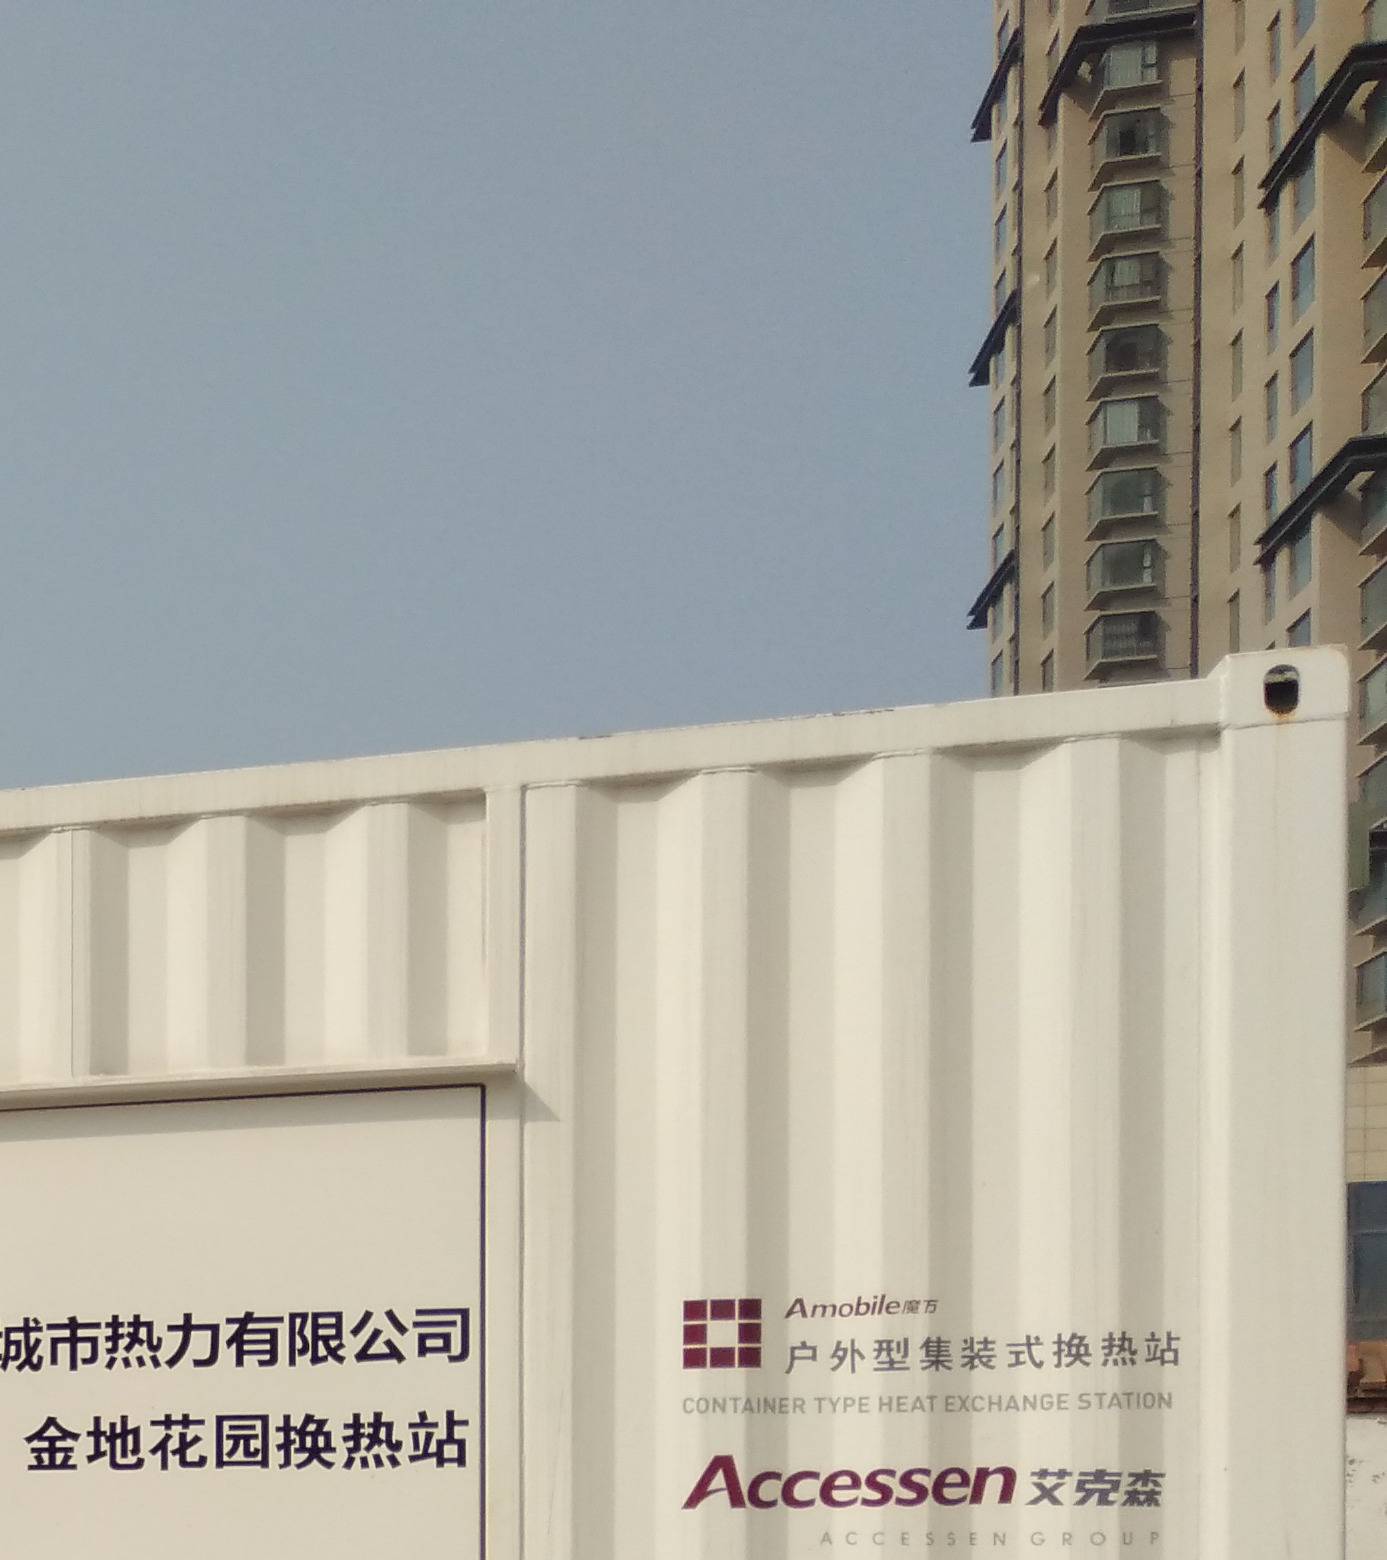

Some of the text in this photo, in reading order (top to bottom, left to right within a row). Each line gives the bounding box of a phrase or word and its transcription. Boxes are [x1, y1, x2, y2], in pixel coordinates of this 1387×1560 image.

[783, 1293, 901, 1320] Amobile
[784, 1330, 1182, 1376] 户外型集装式换热站
[682, 1391, 1174, 1415] CONTAINER TYPE HEAT EXCHANGE STATION
[23, 1409, 471, 1472] 金地花园换热站
[681, 1454, 1166, 1510] Accessen 艾克森
[819, 1531, 1161, 1547] ACCESSEN GROUP
